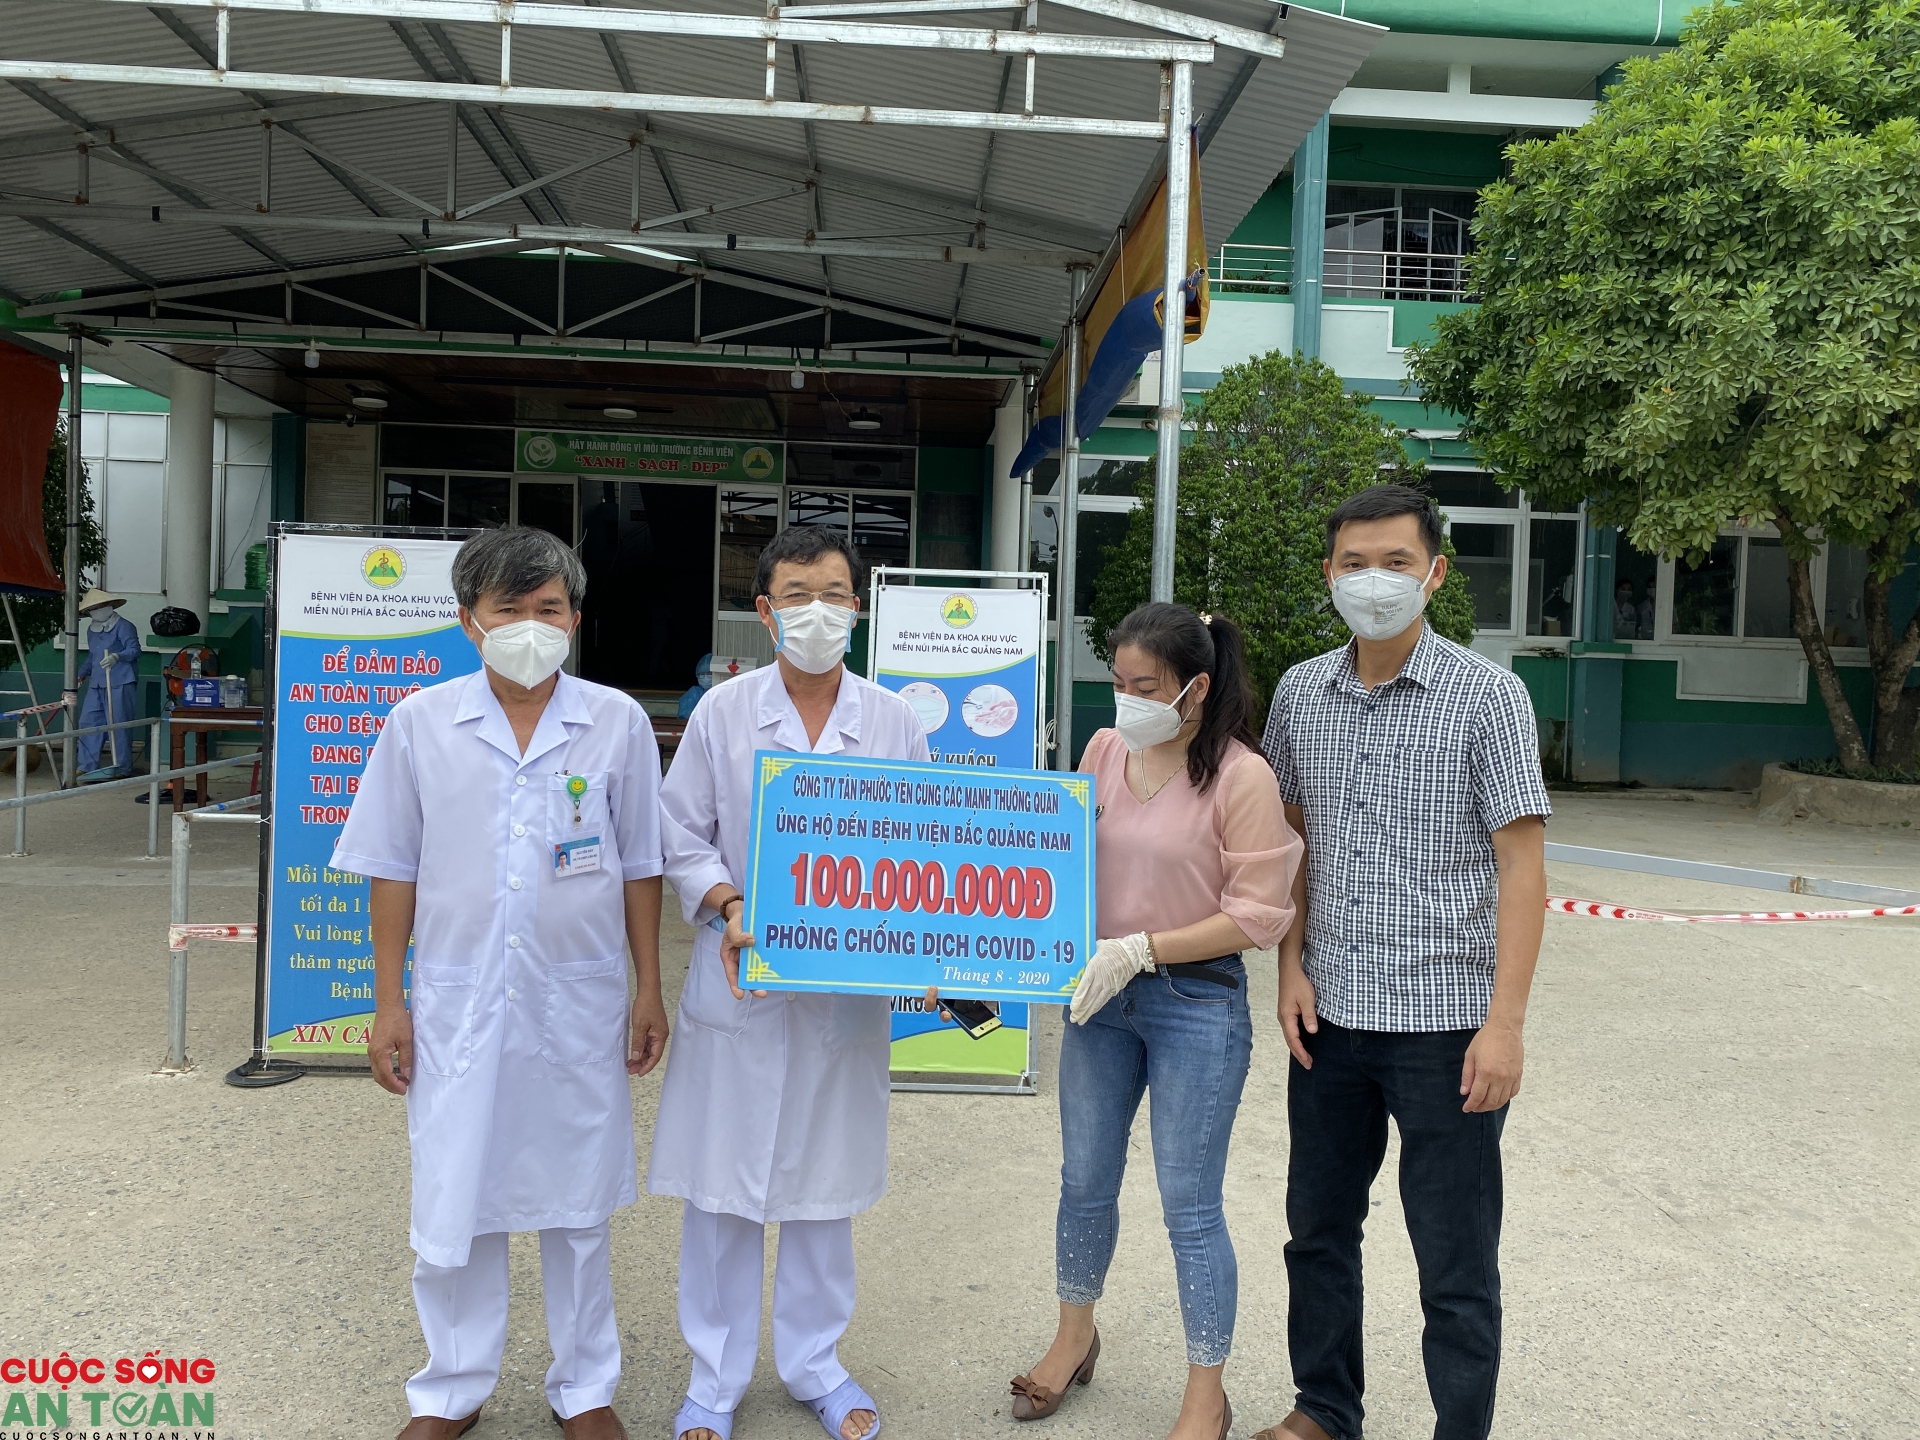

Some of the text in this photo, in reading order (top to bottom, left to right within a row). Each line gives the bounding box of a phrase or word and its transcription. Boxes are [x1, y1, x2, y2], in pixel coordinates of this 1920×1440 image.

[587, 440, 608, 451] HÀNH
[610, 441, 632, 453] ĐỘNG
[633, 442, 641, 452] VÌ
[643, 442, 659, 453] MÔI
[661, 443, 691, 455] TRƯỜNG
[693, 445, 714, 458] BỆNH
[715, 446, 734, 458] VIỆN
[638, 459, 679, 473] SẠCH
[311, 591, 455, 606] BỆNH VIỆN ĐA KHOA KHU VỰC
[303, 604, 329, 615] MIỀN
[331, 606, 349, 616] NÚI
[351, 606, 373, 617] PHÍA
[375, 605, 396, 617] BẮC
[399, 606, 436, 618] QUẢNG
[898, 630, 1017, 645] BỆNH VIỆN ĐA KHOA KHU VỰC
[892, 641, 1023, 656] MIỀN NÚI PHÍA BẮC QUẢNG NAM
[323, 646, 441, 675] ĐỂ ĐẢM BẢO
[289, 683, 315, 702] AN
[319, 680, 369, 703] TOÀN
[304, 712, 387, 737] CHO BỆN
[311, 745, 362, 764] ĐANG
[310, 775, 341, 797] TẠI
[793, 770, 821, 798] CÔNG
[823, 776, 837, 799] TY
[838, 772, 858, 801] TÂN
[860, 775, 892, 804] PHƯỚC
[894, 777, 913, 805] YÊN
[915, 778, 942, 807] CÙNG
[943, 780, 962, 808] CÁC
[964, 787, 992, 816] MẠNH
[993, 783, 1031, 814] THƯỜNG
[300, 805, 350, 824] TRON
[775, 806, 1071, 852] ỦNG HỘ ĐẾN BỆNH VIỆN BẮC QUẢNG NAM
[286, 863, 317, 883] Mỗi
[790, 852, 1056, 920] 100.000.000Đ
[300, 893, 323, 913] tối
[328, 896, 347, 913] đa
[354, 897, 361, 913] 1
[294, 924, 321, 941] Vui
[327, 924, 363, 945] lòng
[765, 919, 838, 952] PHÒNG
[844, 919, 917, 956] CHỐNG
[922, 932, 970, 964] DỊCH
[975, 934, 1036, 962] COVID
[1053, 939, 1075, 964] 19
[290, 953, 376, 973] thăm ngườ
[942, 966, 990, 985] Tháng
[994, 969, 1004, 983] 8
[1017, 971, 1050, 985] 2020
[330, 981, 372, 1001] Bệnh
[291, 1020, 371, 1044] XIN CẢ
